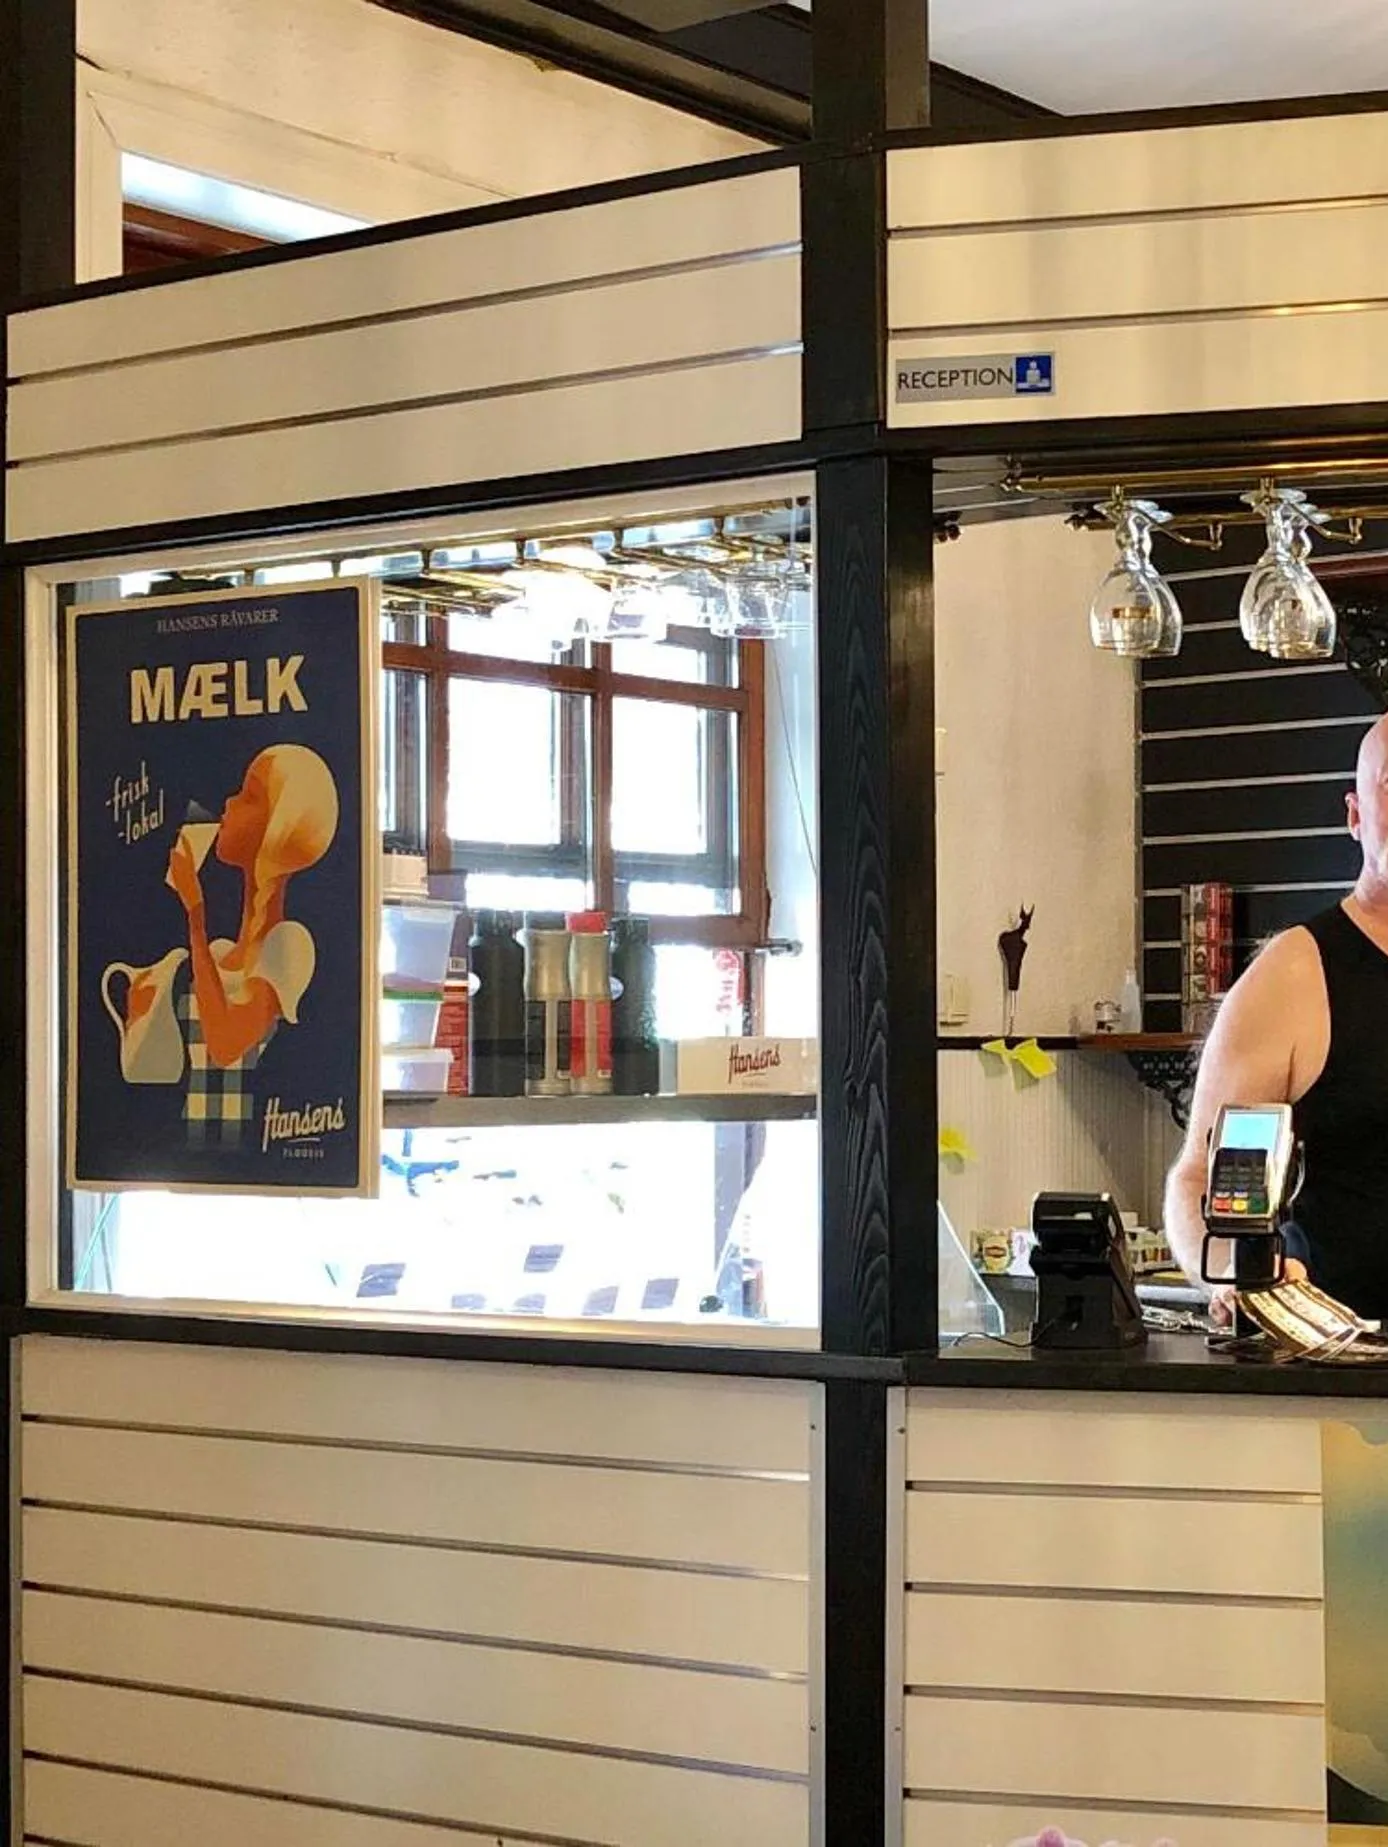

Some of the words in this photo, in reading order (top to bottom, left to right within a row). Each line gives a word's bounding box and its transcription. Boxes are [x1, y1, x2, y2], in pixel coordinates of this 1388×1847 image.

[898, 367, 1013, 390] RECEPTION
[157, 615, 218, 633] HANSENS
[129, 655, 309, 725] MÆLK
[728, 1042, 782, 1084] Hansens
[261, 1097, 346, 1153] Hansens
